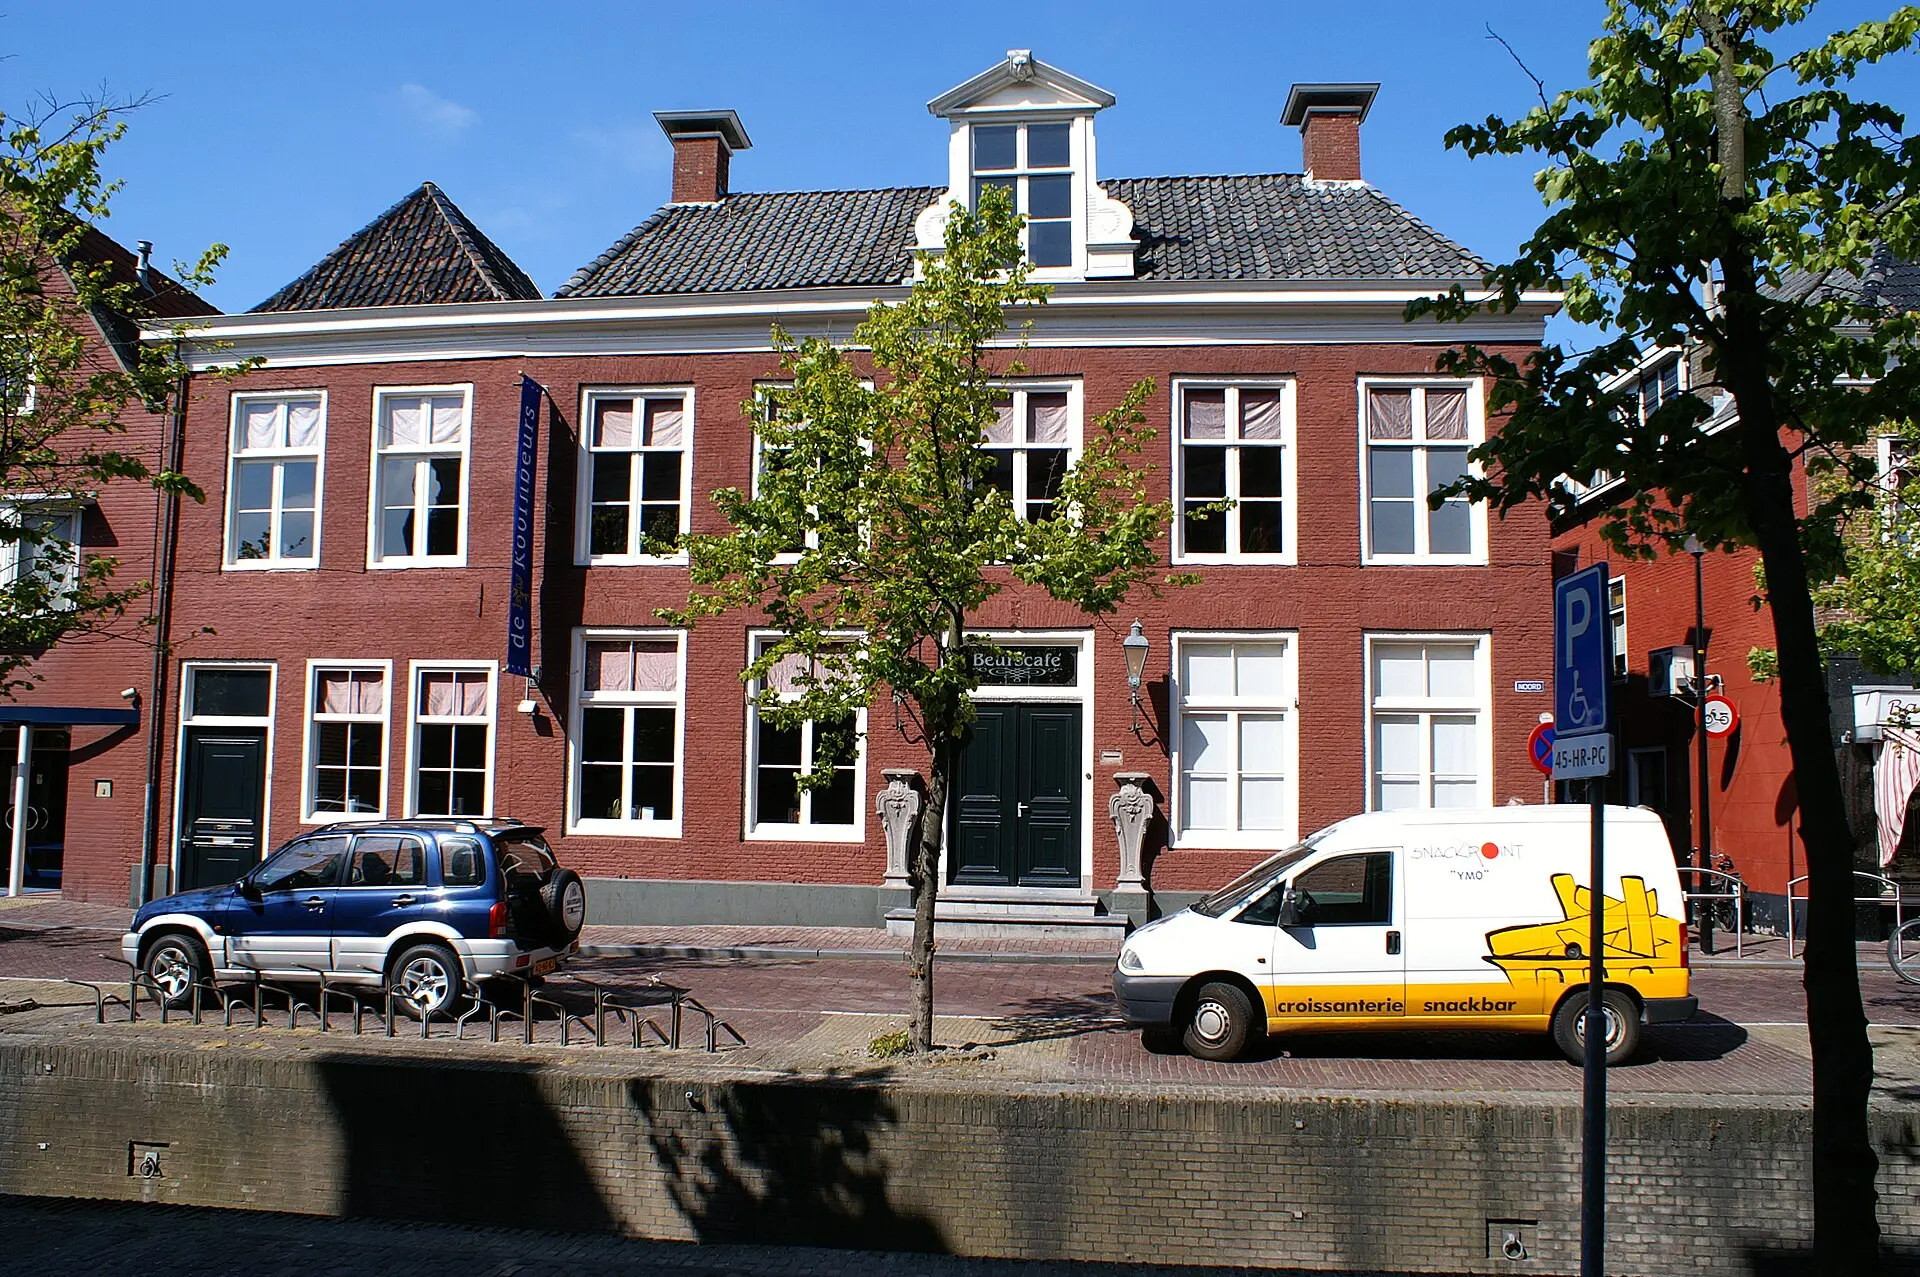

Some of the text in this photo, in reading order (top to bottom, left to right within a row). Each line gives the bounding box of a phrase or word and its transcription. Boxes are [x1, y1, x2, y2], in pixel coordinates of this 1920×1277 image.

[510, 617, 524, 649] de
[1566, 587, 1591, 669] P
[1555, 745, 1605, 769] 45-HR-PG
[1277, 996, 1517, 1013] croissanterie snackbar
